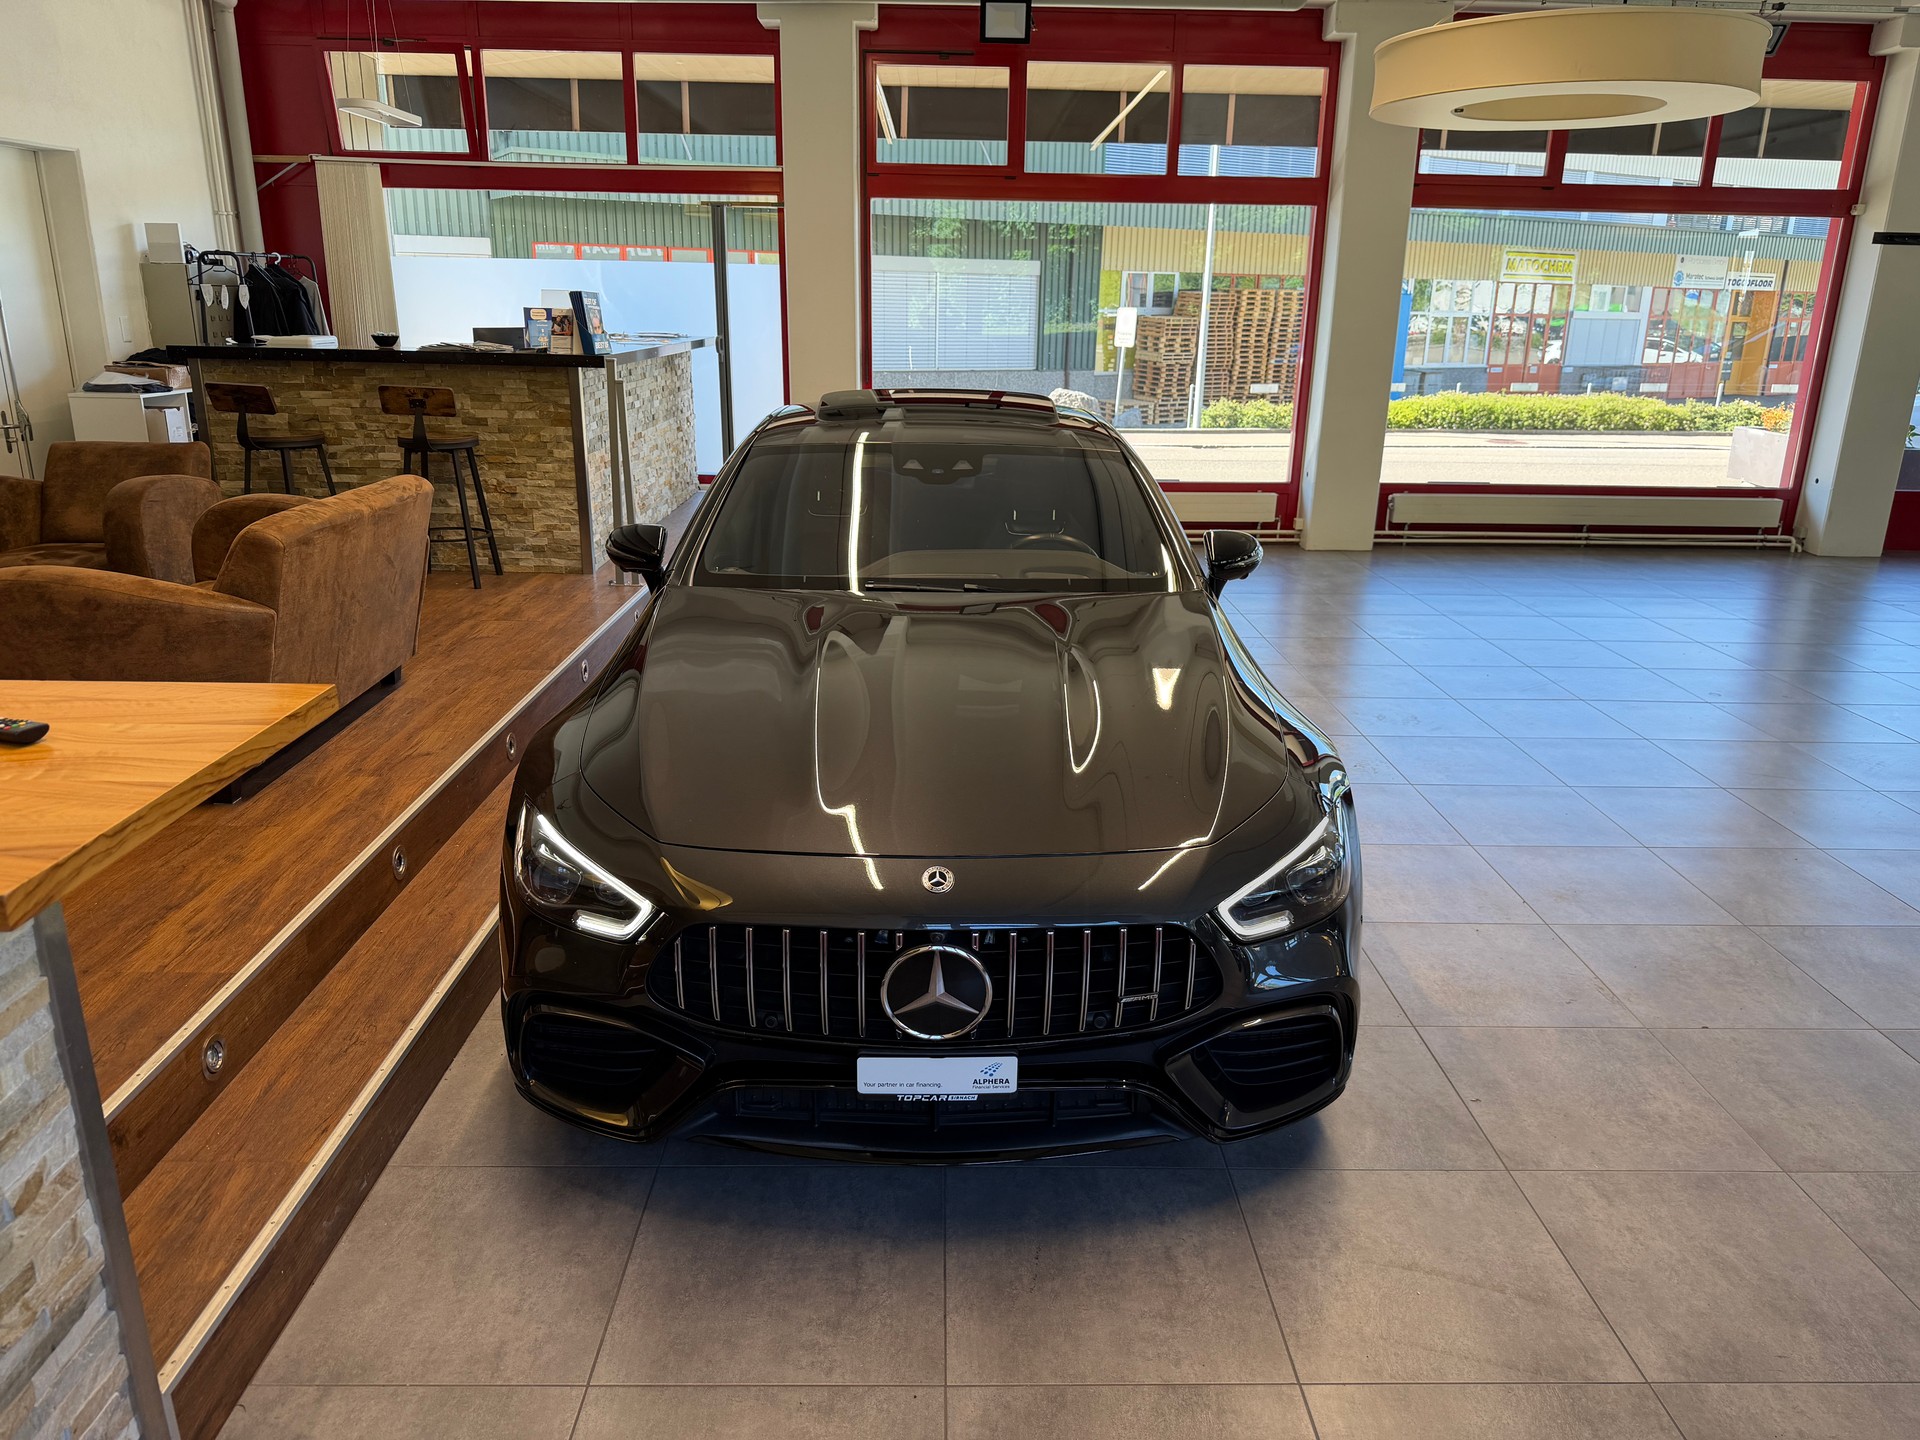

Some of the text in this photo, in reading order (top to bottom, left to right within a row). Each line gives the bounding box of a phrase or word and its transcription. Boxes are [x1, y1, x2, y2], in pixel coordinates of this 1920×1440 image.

[1505, 258, 1574, 274] MATOCHEM
[916, 1081, 943, 1089] financing.
[896, 1094, 949, 1102] TOPCAR
